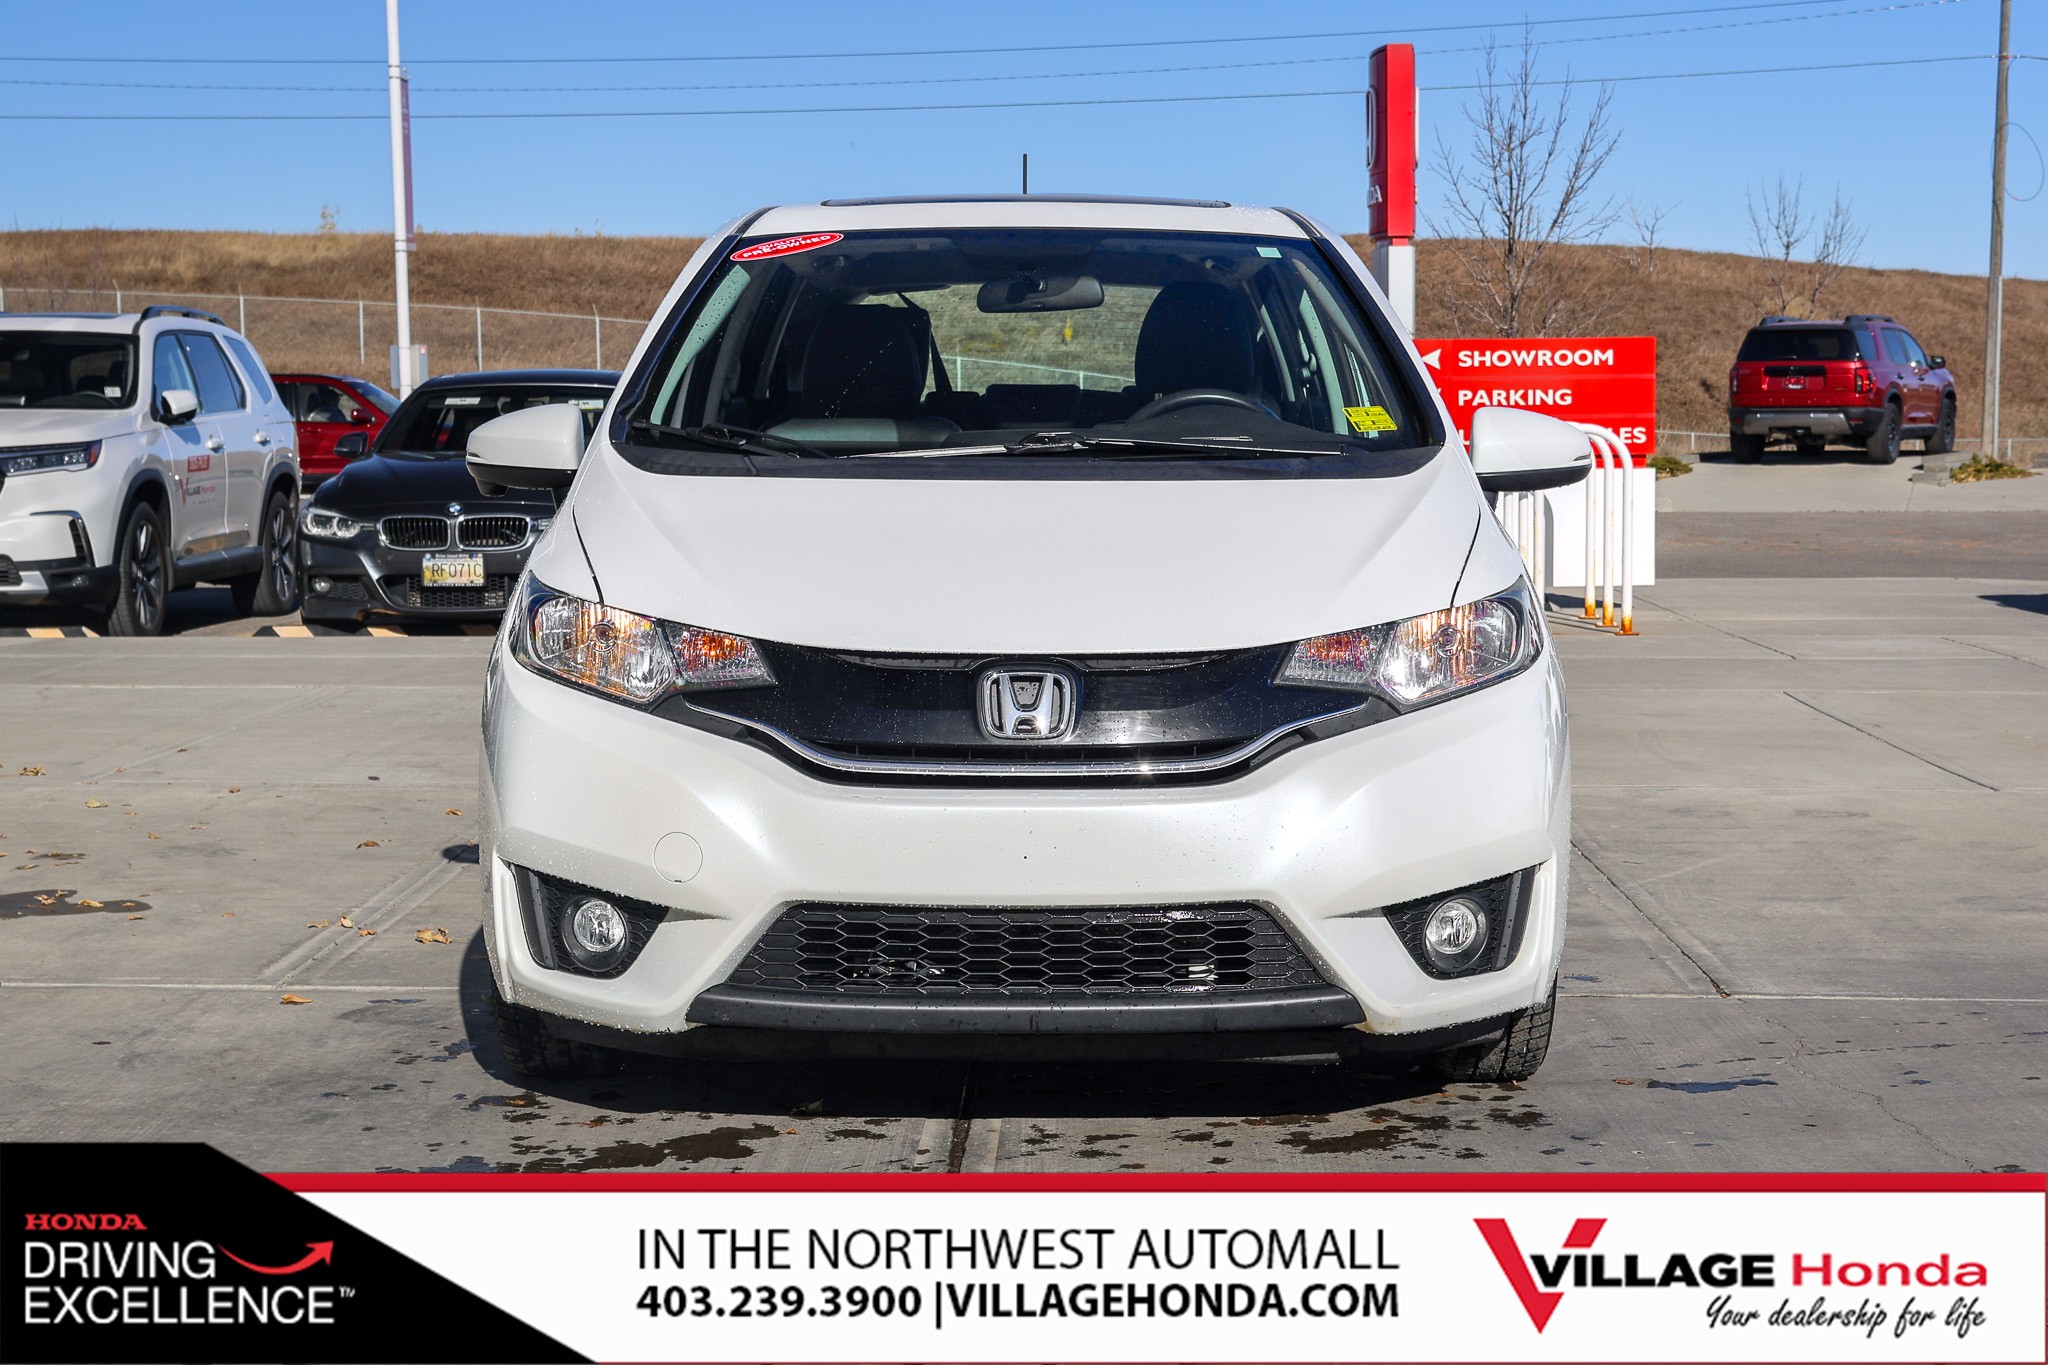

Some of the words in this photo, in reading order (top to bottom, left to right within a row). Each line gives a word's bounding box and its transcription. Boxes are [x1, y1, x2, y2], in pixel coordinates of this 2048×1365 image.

[742, 235, 831, 258] PRE-OWNED
[758, 237, 803, 250] QUALITY
[1458, 349, 1614, 368] SHOWROOM
[1458, 389, 1573, 407] PARKING
